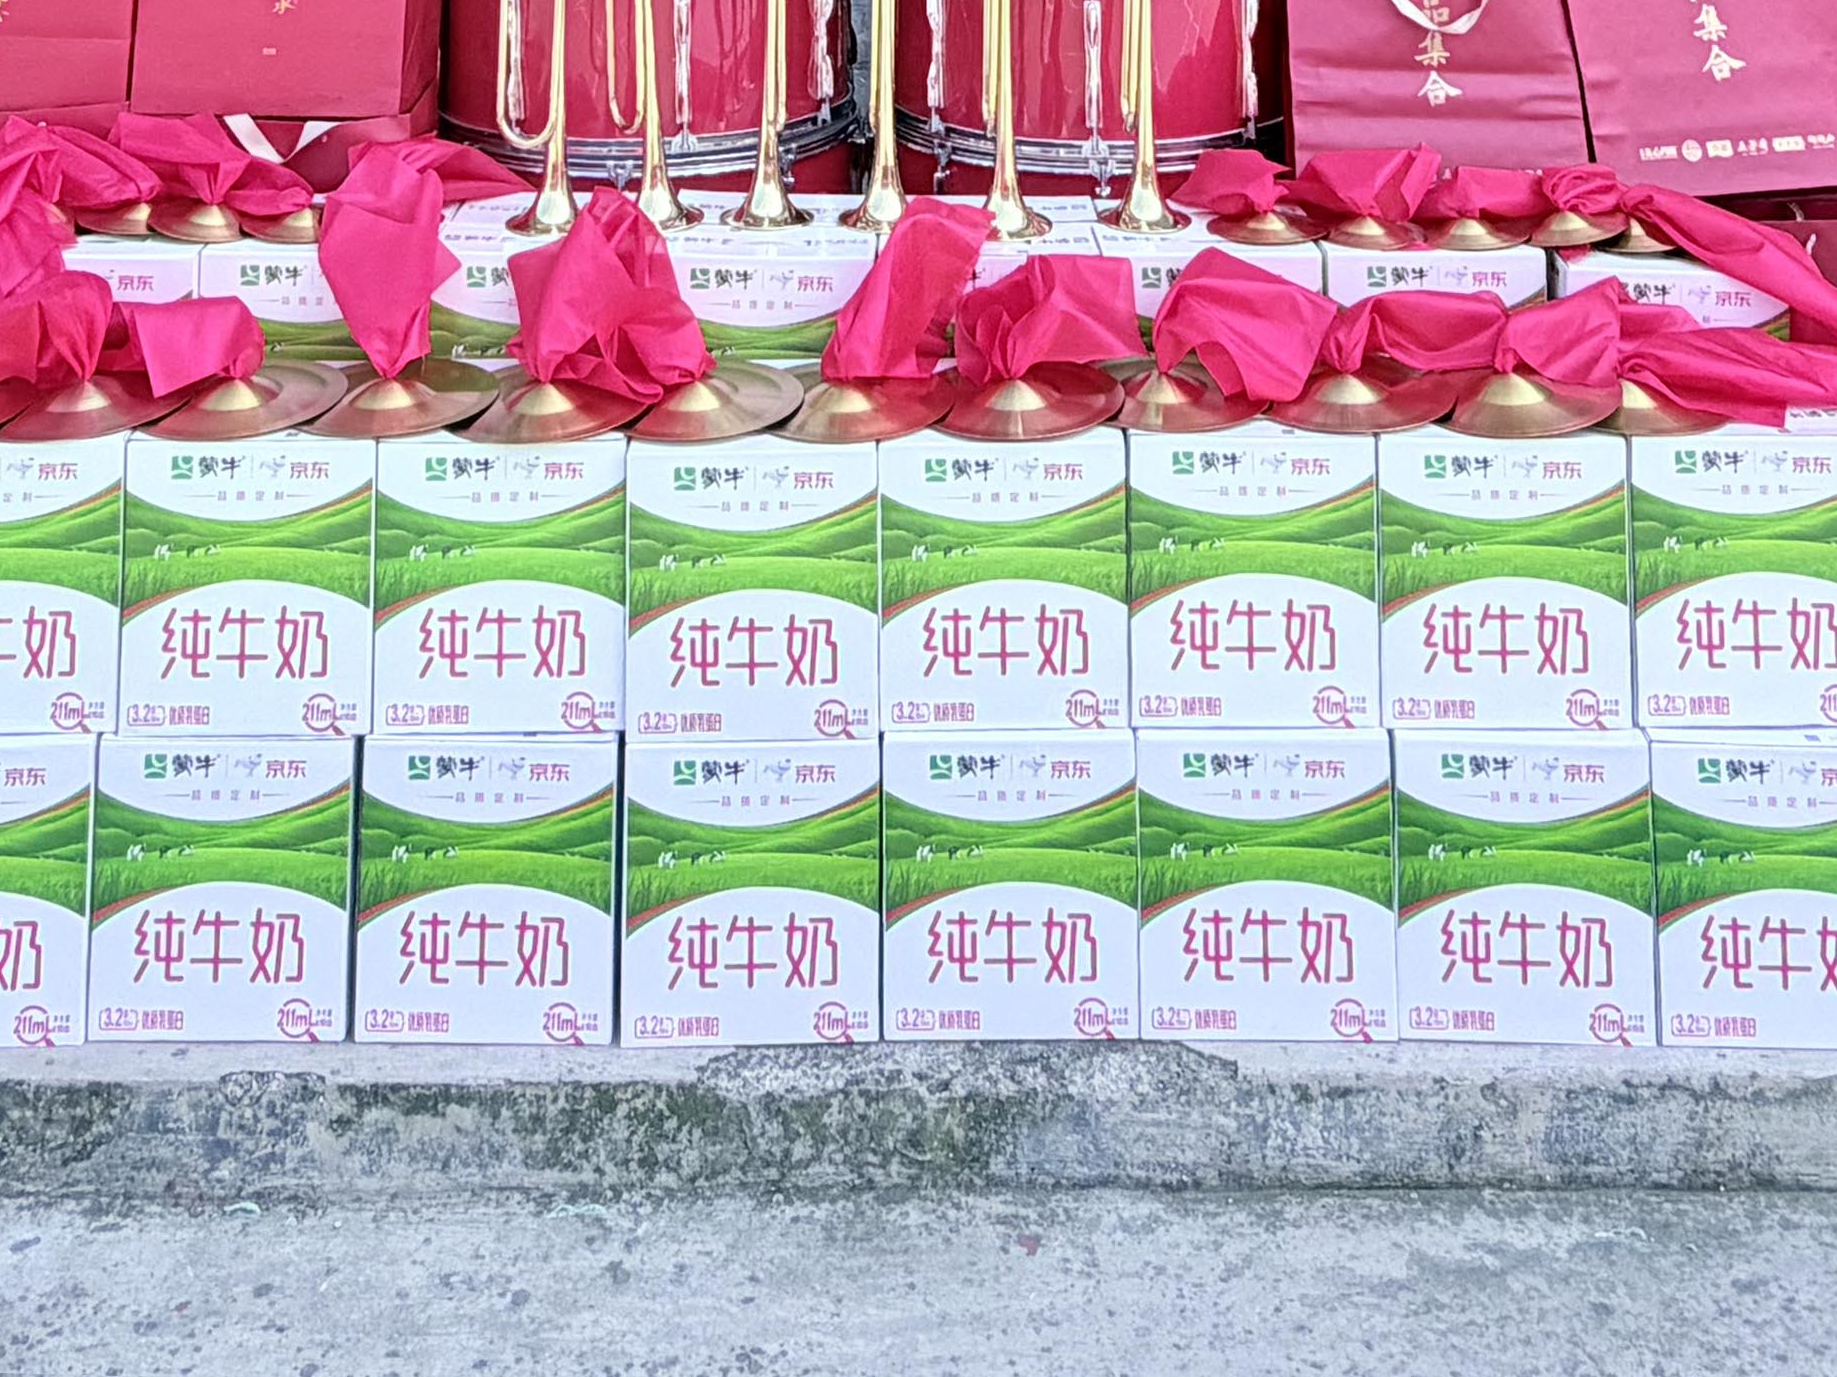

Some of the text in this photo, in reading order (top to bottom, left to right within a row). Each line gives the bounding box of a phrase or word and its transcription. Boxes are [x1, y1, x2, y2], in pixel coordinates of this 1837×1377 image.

[116, 275, 154, 292] 京东
[265, 266, 304, 287] 蒙牛
[714, 267, 835, 292] 蒙牛 京东
[1391, 266, 1507, 288] 蒙牛 京东
[1715, 290, 1752, 308] 京东
[38, 463, 77, 480] 京东
[198, 455, 329, 479] 蒙牛 京东
[452, 456, 583, 480] 蒙牛 京东
[951, 457, 1082, 481] 蒙牛 京东
[1199, 451, 1330, 475] 蒙牛 京东
[1451, 455, 1581, 479] 蒙牛 京东
[1701, 449, 1831, 473] 蒙牛 京东
[700, 466, 833, 490] 蒙牛 京东
[161, 605, 328, 679] 纯牛奶
[418, 604, 586, 678] 纯牛奶
[921, 604, 1089, 677] 纯牛奶
[1169, 598, 1336, 671] 纯牛奶
[1422, 601, 1589, 674] 纯牛奶
[669, 613, 838, 687] 纯牛奶
[5, 768, 45, 786] 京东
[172, 753, 306, 778] 蒙牛 京东
[436, 755, 569, 782] 蒙牛 京东
[701, 759, 835, 784] 蒙牛 京东
[956, 754, 1091, 779] 蒙牛 京东
[1210, 752, 1345, 778] 蒙牛 京东
[1469, 754, 1604, 782] 蒙牛 京东
[1725, 758, 1772, 784] 蒙牛
[134, 907, 304, 983] 纯牛奶
[399, 909, 569, 987] 纯牛奶
[667, 912, 838, 989] 纯牛奶
[926, 907, 1098, 983] 纯牛奶
[1181, 906, 1354, 983] 纯牛奶
[1439, 908, 1613, 987] 纯牛奶
